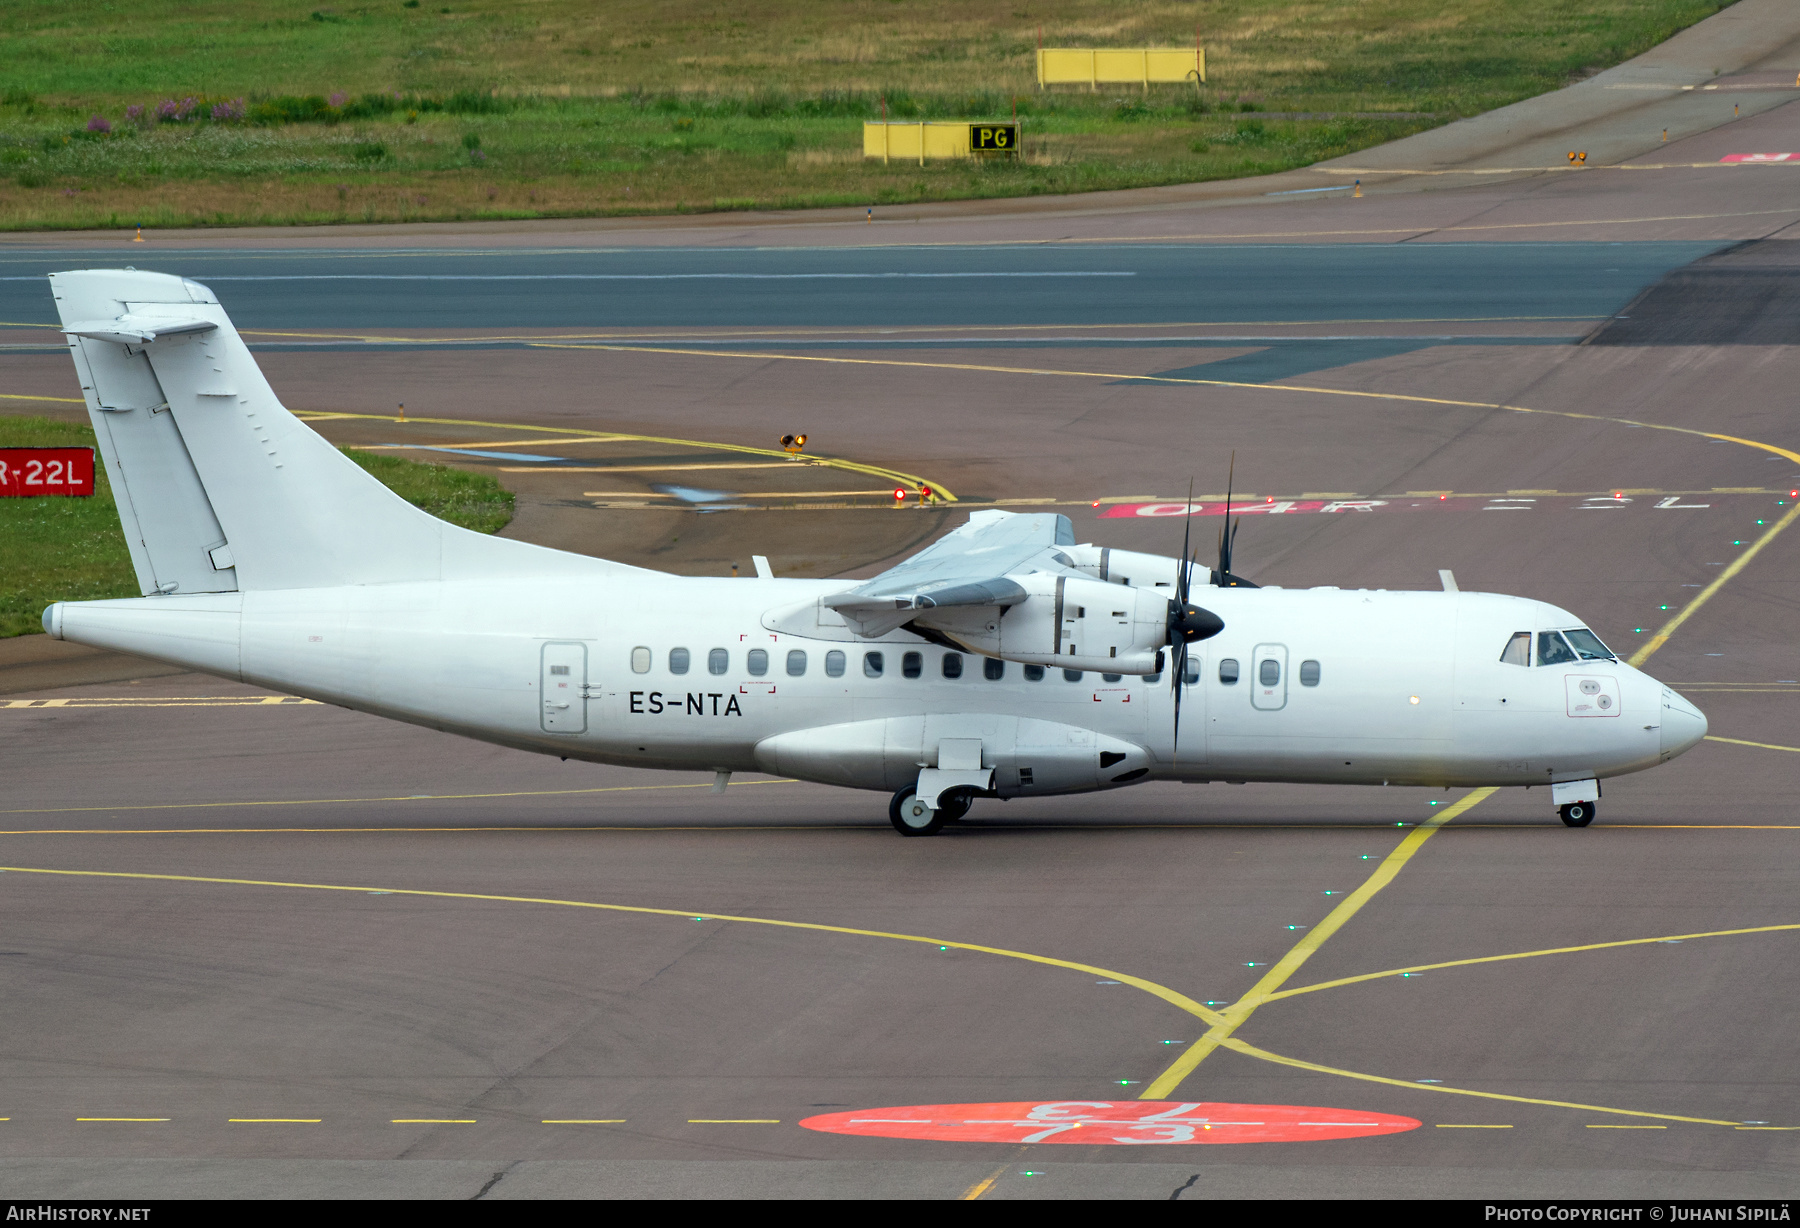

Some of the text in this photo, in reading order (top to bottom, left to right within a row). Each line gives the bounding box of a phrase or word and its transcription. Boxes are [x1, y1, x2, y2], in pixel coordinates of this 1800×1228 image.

[980, 128, 1007, 147] PG
[630, 691, 742, 716] ES-NTA
[1013, 1123, 1196, 1144] 73
